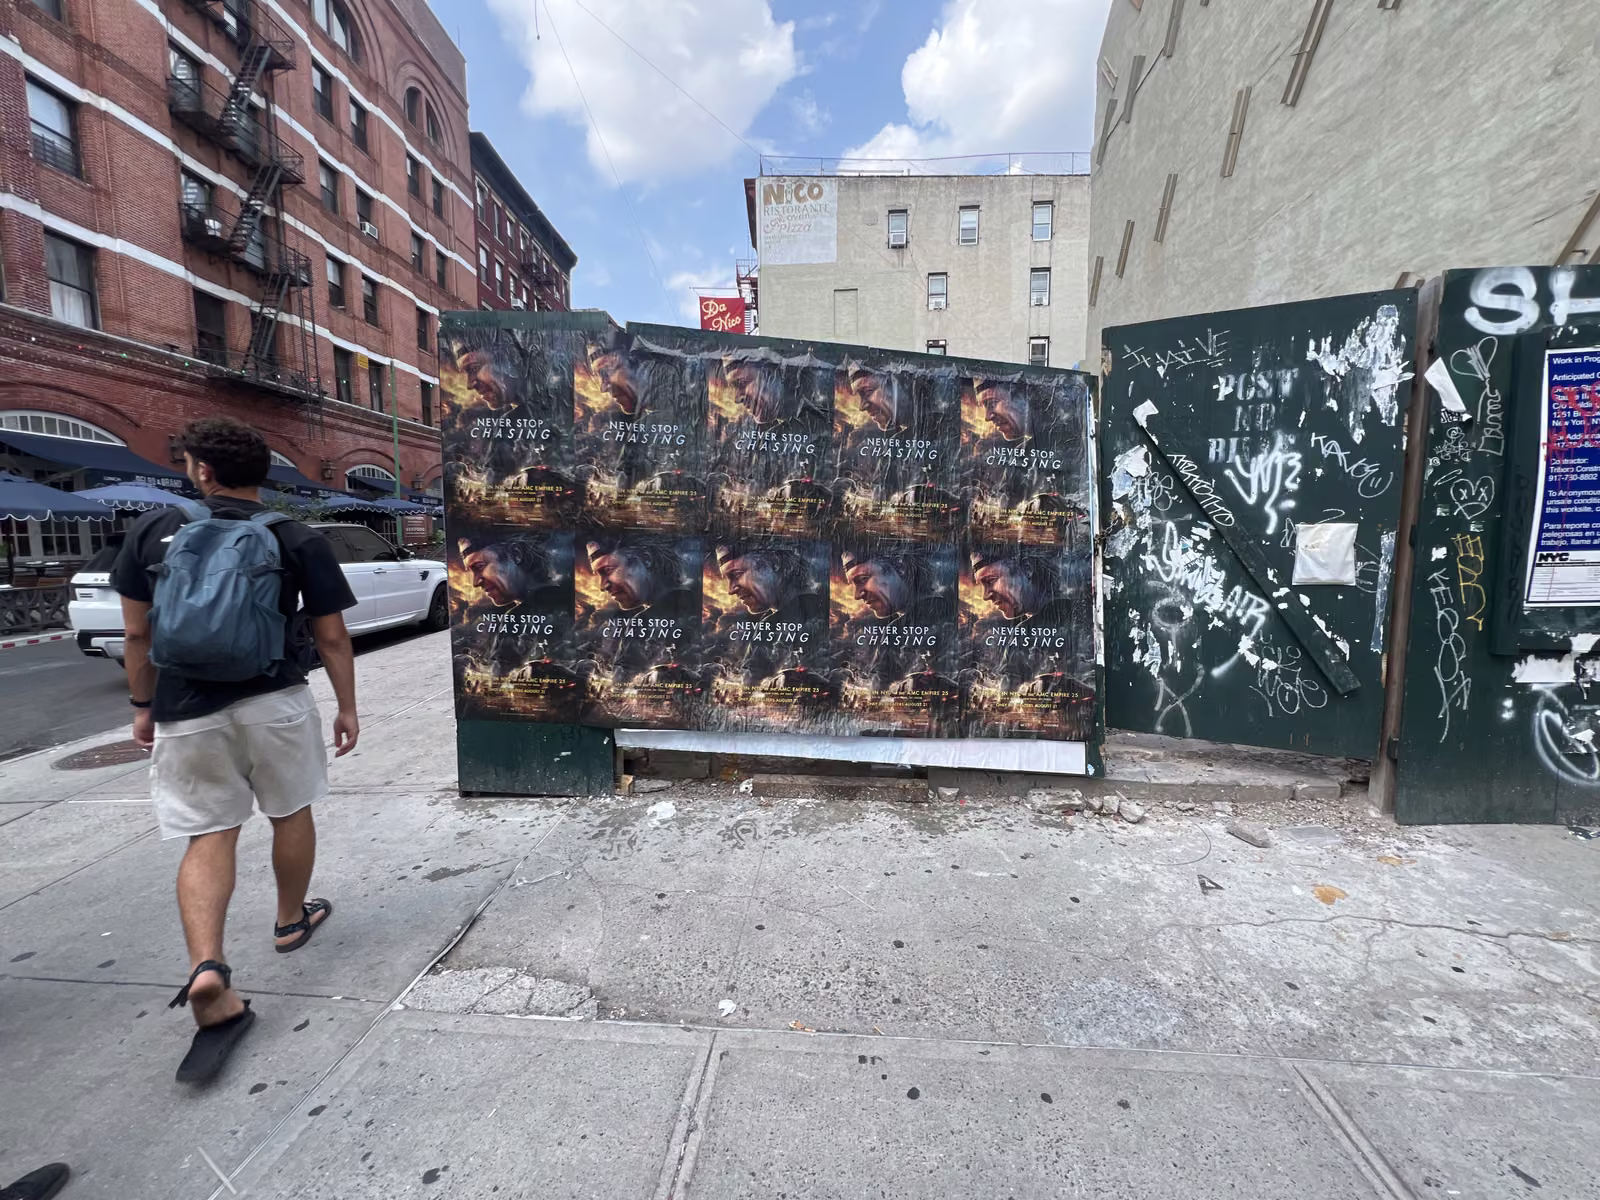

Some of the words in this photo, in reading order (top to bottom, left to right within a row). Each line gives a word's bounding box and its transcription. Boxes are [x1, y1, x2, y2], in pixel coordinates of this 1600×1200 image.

[764, 204, 831, 216] RISTORANTE
[702, 300, 727, 320] Da
[712, 312, 741, 331] Nico
[1552, 372, 1595, 381] Anticipated
[1217, 367, 1299, 401] POST
[477, 418, 511, 427] NEVER
[517, 419, 543, 428] STOP
[610, 421, 645, 432] NEVER
[651, 424, 678, 433] STOP
[471, 428, 551, 439] CHASING
[603, 431, 686, 444] CHASING
[742, 431, 776, 440] NEVER
[782, 434, 808, 442] STOP
[735, 440, 815, 453] CHASING
[867, 438, 900, 447] NEVER
[906, 440, 930, 448] STOP
[860, 446, 938, 459] CHASING
[993, 447, 1025, 456] NEVER
[1031, 449, 1054, 458] STOP
[986, 456, 1061, 469] CHASING
[1538, 553, 1569, 562] NYC
[482, 614, 515, 623] NEVER
[521, 615, 546, 623] STOP
[608, 618, 643, 626] NEVER
[649, 619, 675, 627] STOP
[476, 623, 553, 634] CHASING
[737, 622, 770, 630] NEVER
[776, 623, 802, 631] STOP
[864, 626, 897, 634] NEVER
[903, 627, 929, 635] STOP
[992, 627, 1026, 636] NEVER
[1032, 628, 1057, 636] STOP
[602, 627, 682, 638] CHASING
[729, 631, 810, 642] CHASING
[856, 636, 936, 645] CHASING
[986, 636, 1064, 647] CHASING
